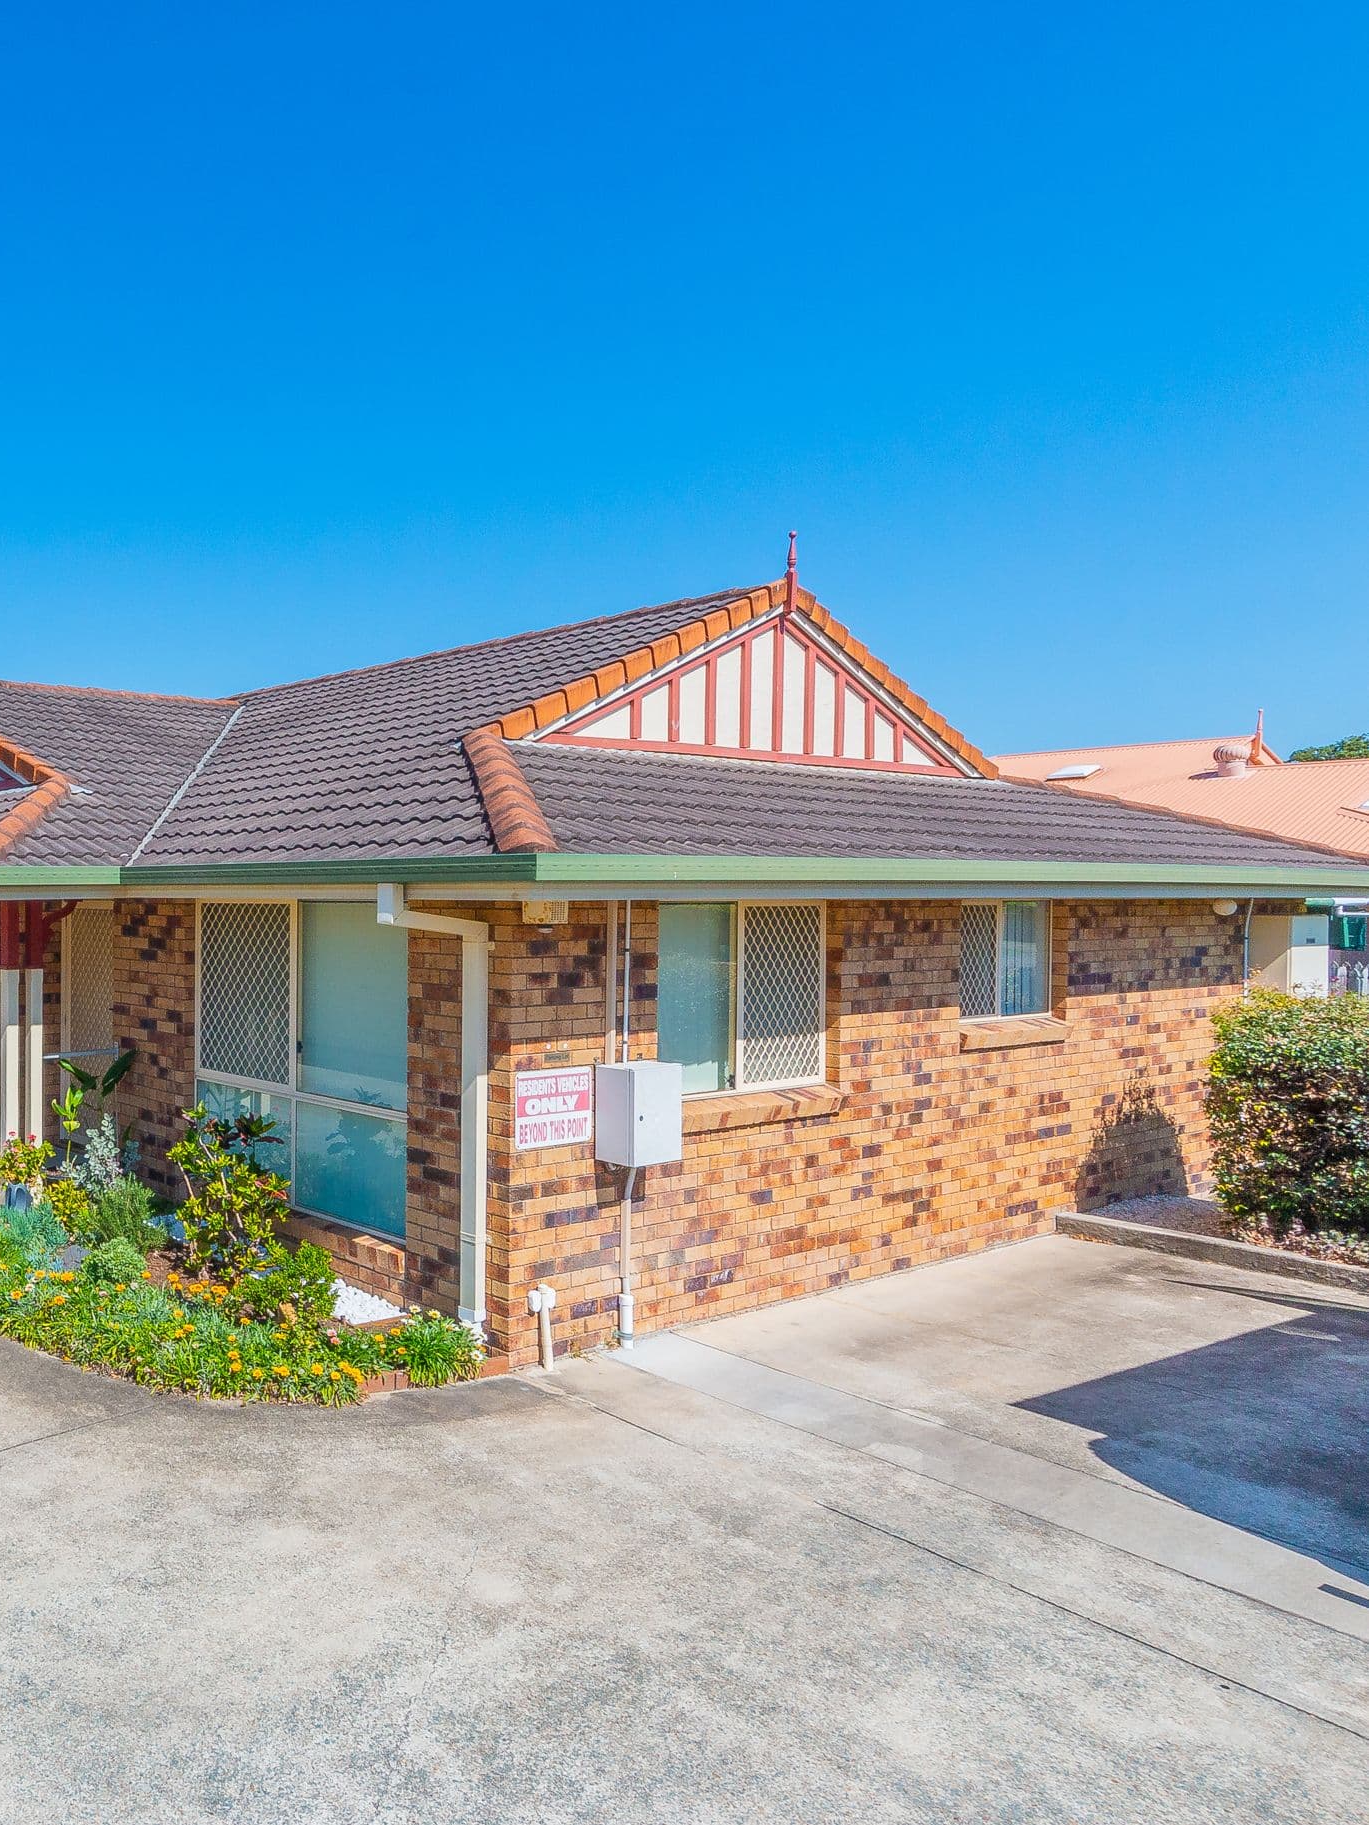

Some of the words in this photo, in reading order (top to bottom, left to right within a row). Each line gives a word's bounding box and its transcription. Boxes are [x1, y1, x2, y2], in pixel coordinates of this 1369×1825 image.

[518, 1077, 557, 1097] RESIDENTS
[557, 1075, 589, 1093] VEHICLES
[525, 1094, 579, 1115] ONLY
[519, 1121, 548, 1144] BEYOND
[550, 1119, 566, 1140] THIS
[567, 1117, 588, 1138] POINT
